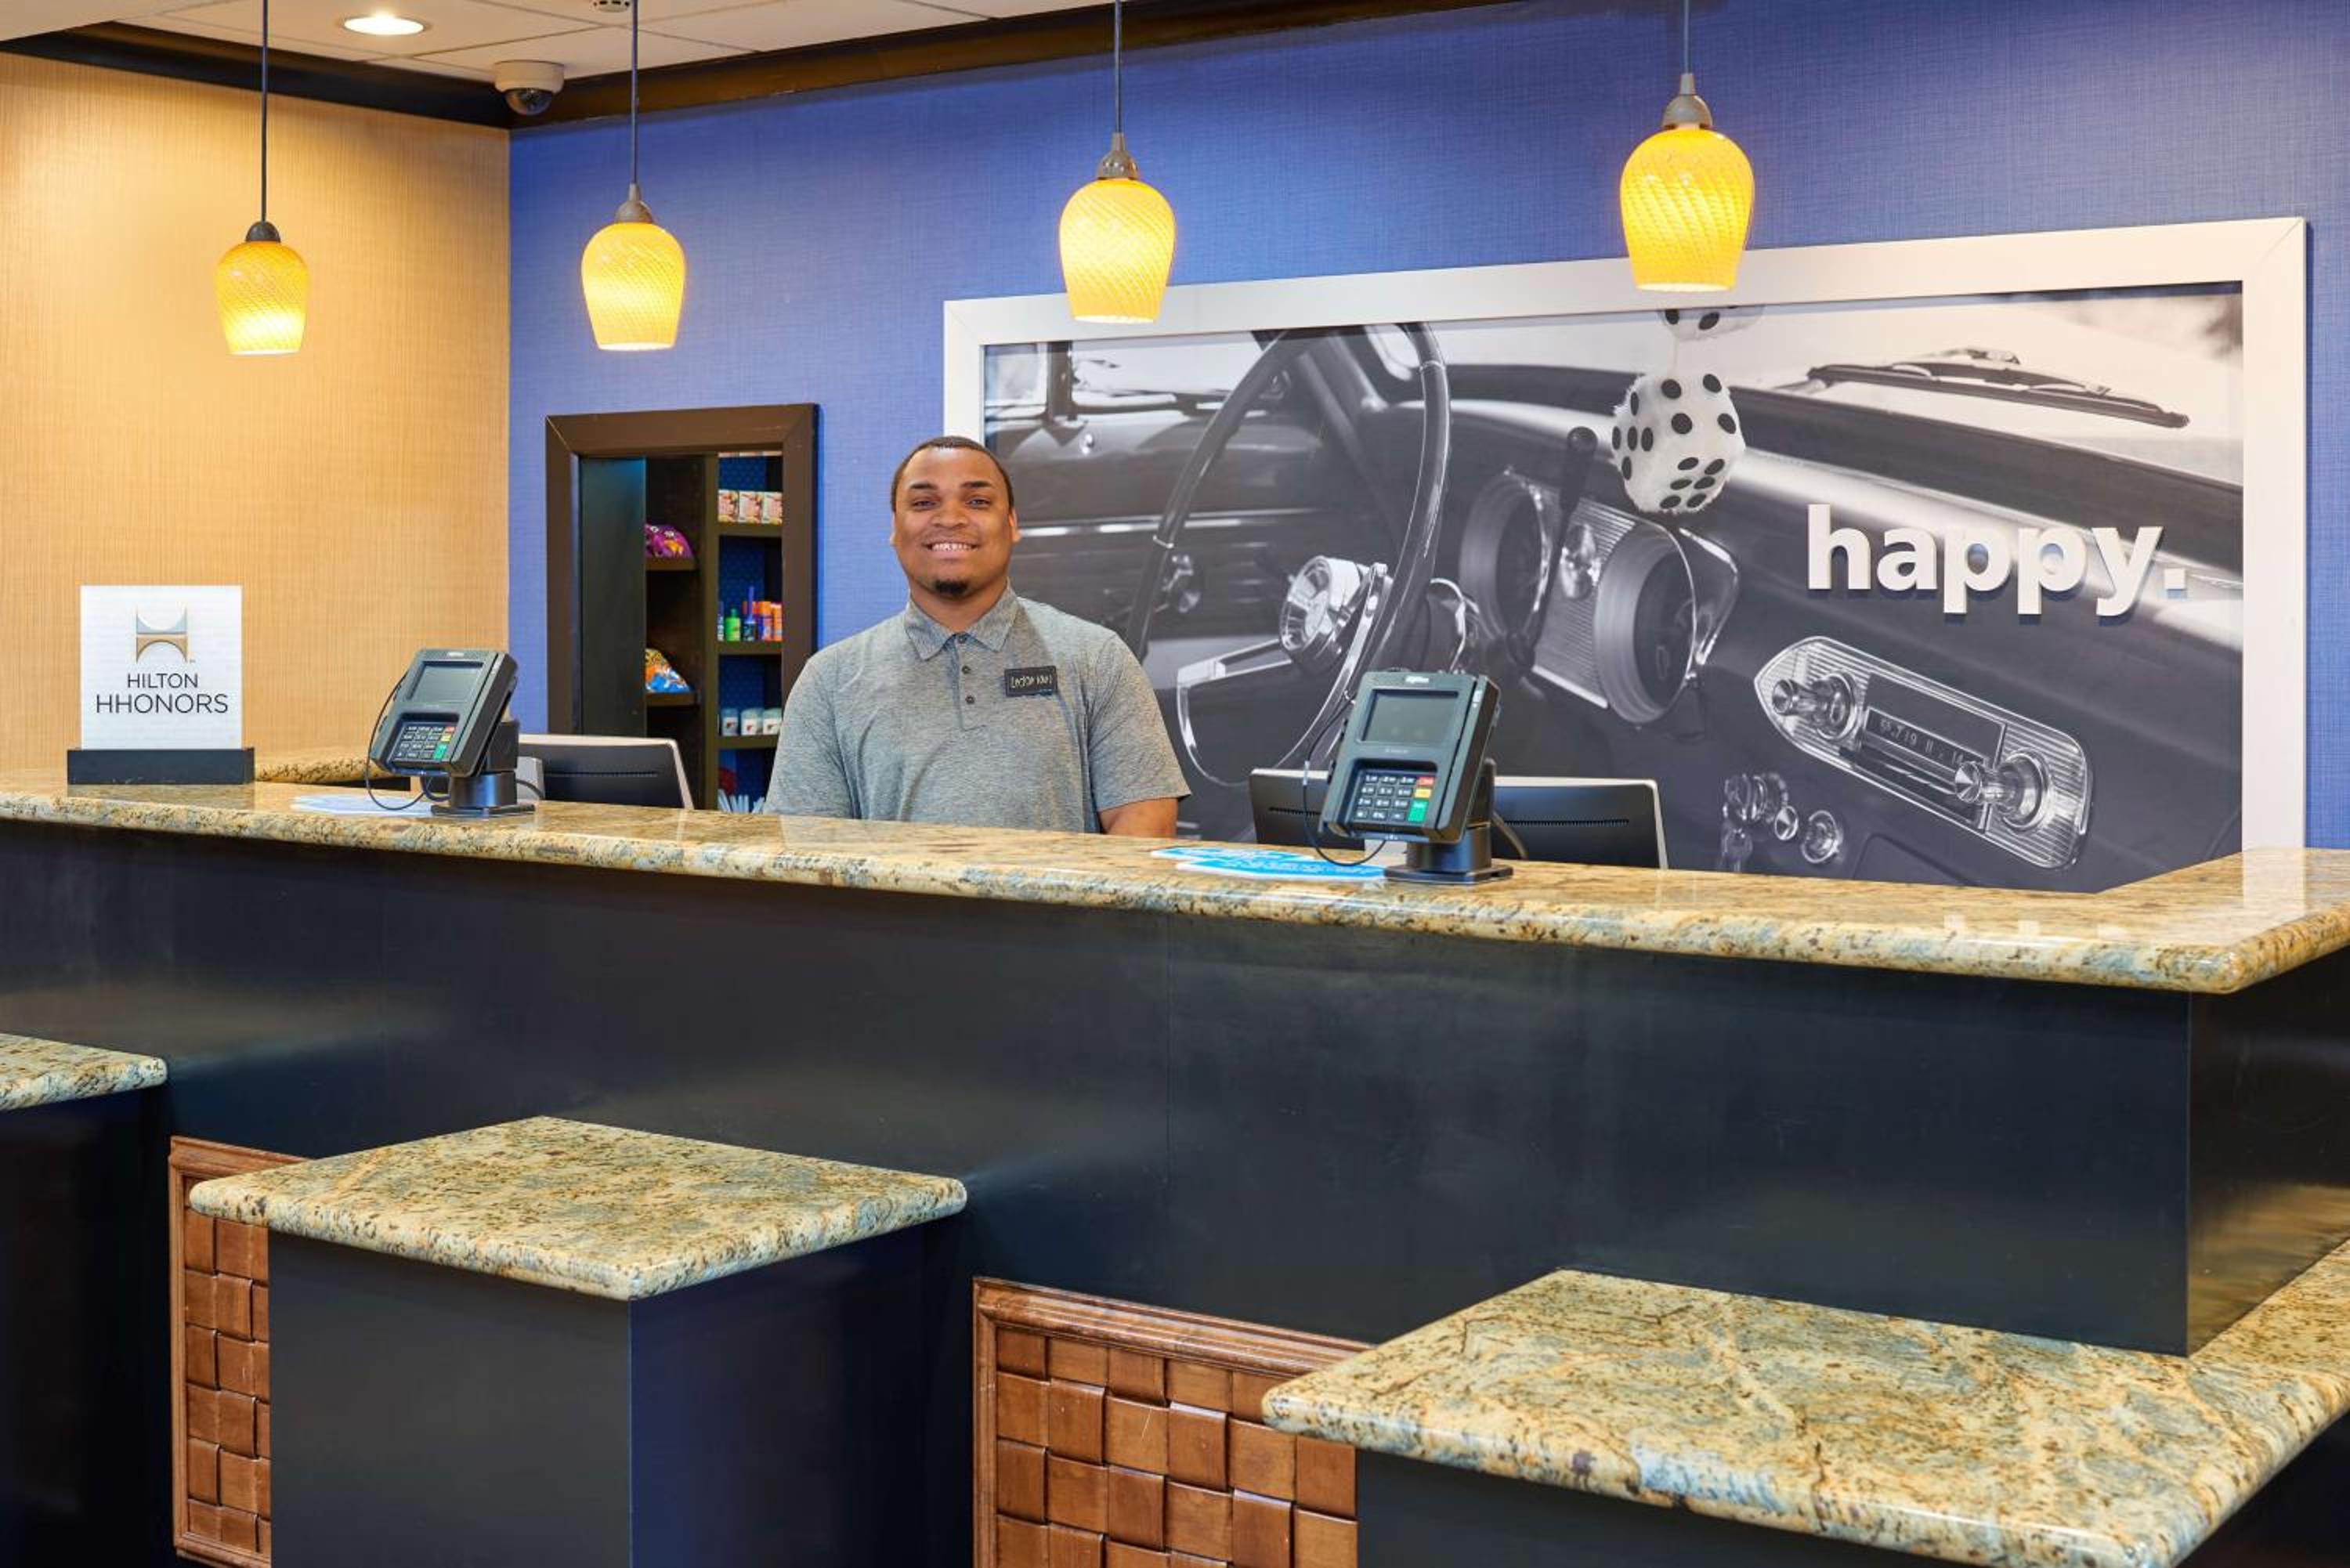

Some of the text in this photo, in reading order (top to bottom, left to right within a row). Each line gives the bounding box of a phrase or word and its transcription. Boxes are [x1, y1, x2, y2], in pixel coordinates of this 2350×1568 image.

[1808, 504, 2186, 616] happy.
[128, 673, 198, 688] HILTON
[96, 694, 228, 714] HHONORS
